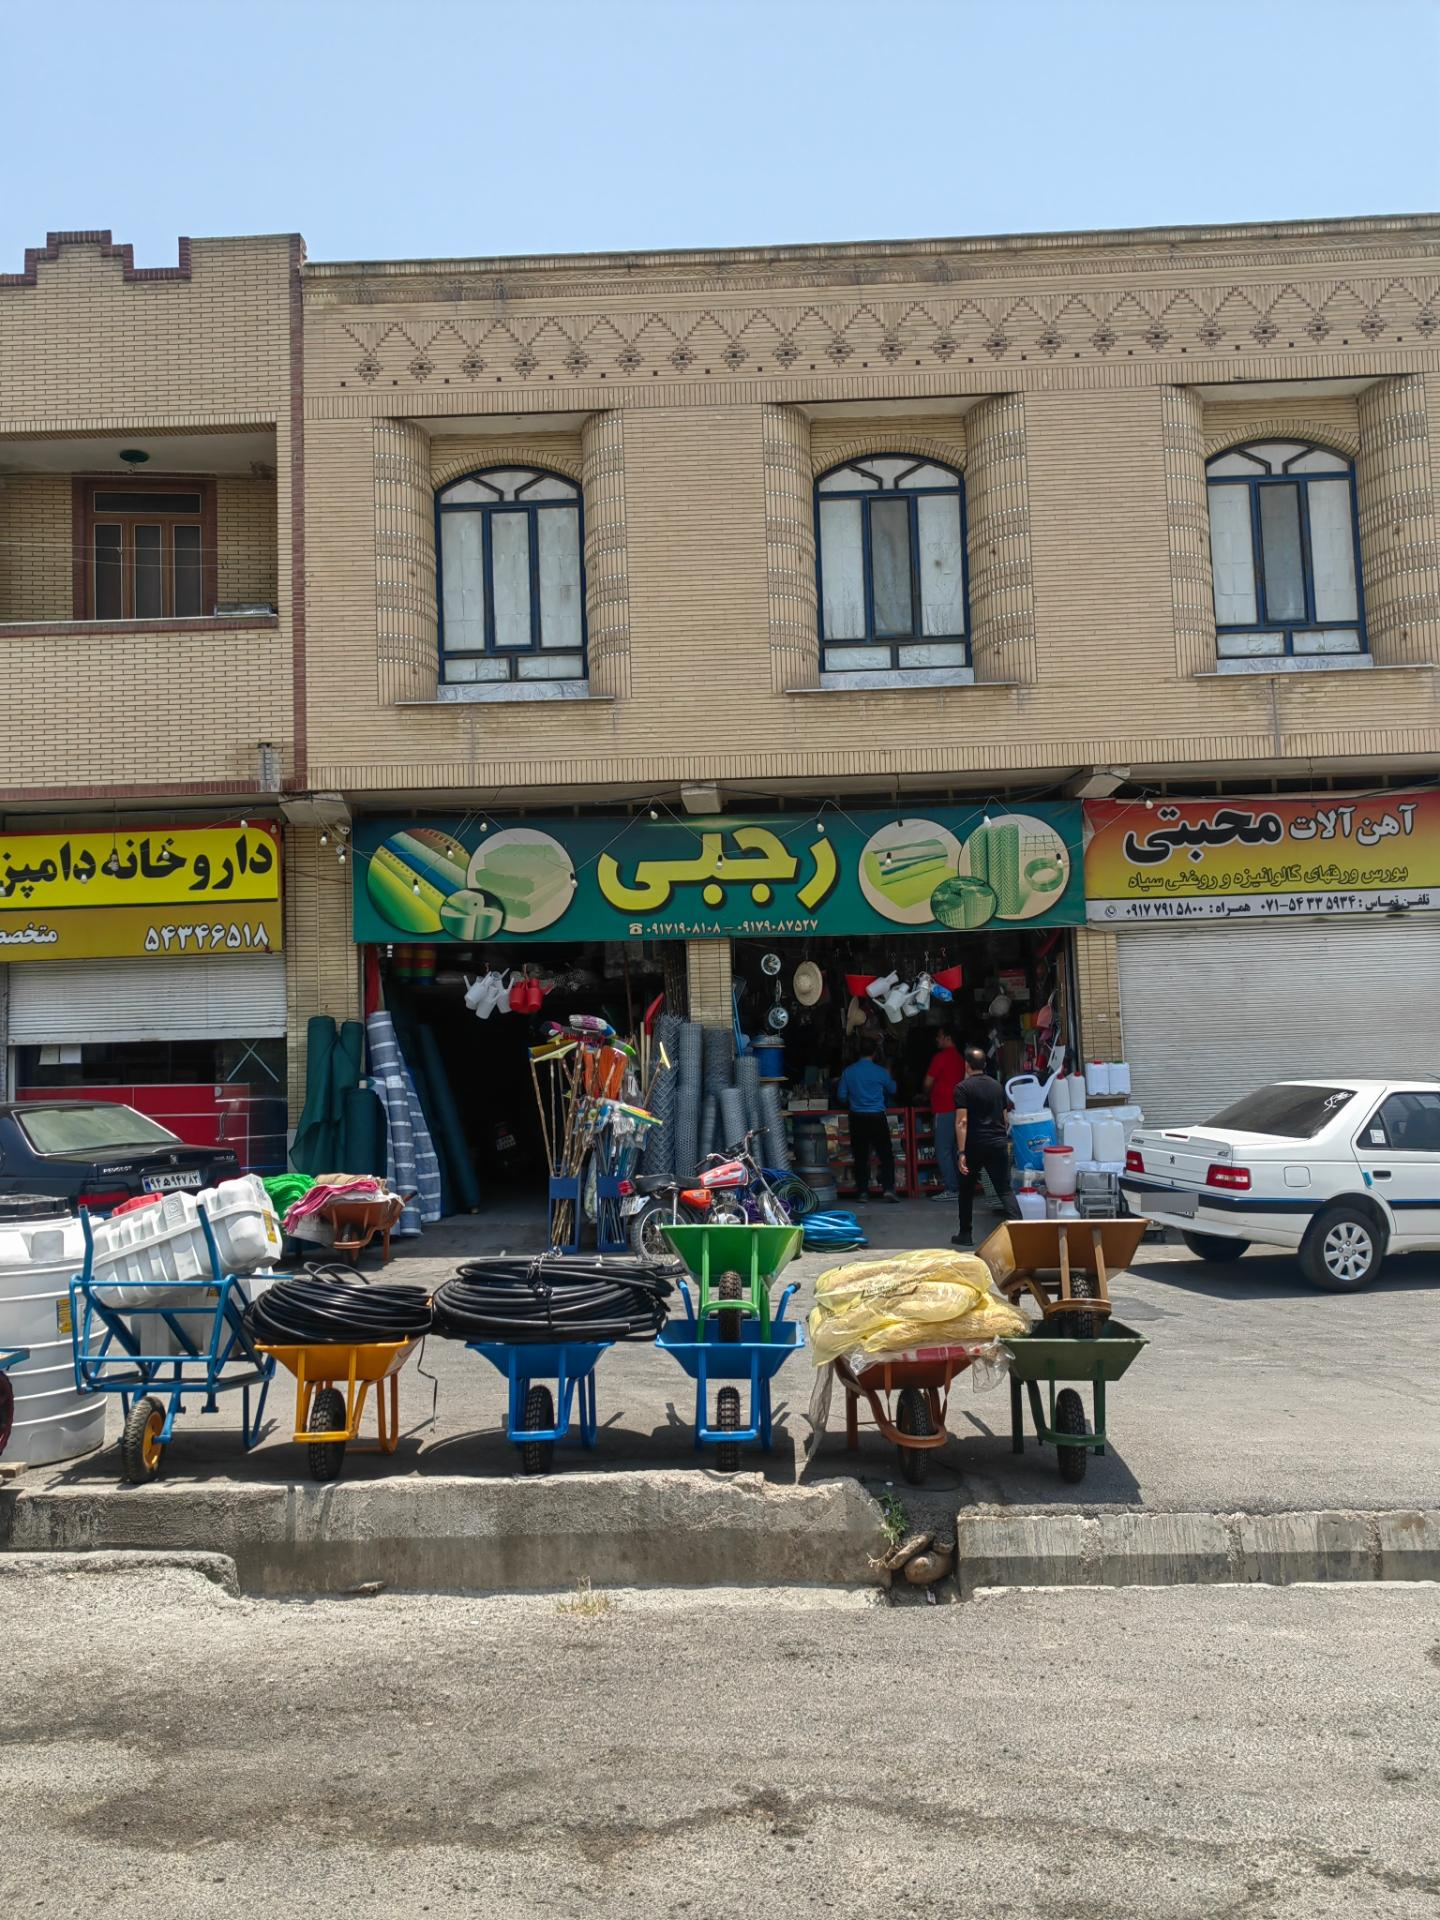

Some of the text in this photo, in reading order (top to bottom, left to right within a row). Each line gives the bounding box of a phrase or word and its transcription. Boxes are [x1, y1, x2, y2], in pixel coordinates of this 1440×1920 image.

[1123, 803, 1418, 865] آهن آلات محبتی
[101, 835, 273, 890] داروخانه
[598, 827, 837, 911] رجبی
[1361, 865, 1408, 883] بورس
[1128, 872, 1163, 892] سیاه
[1165, 870, 1218, 891] روغنی
[1219, 873, 1231, 889] و
[144, 921, 270, 951] ۵۴۳۴۶۵۱۸
